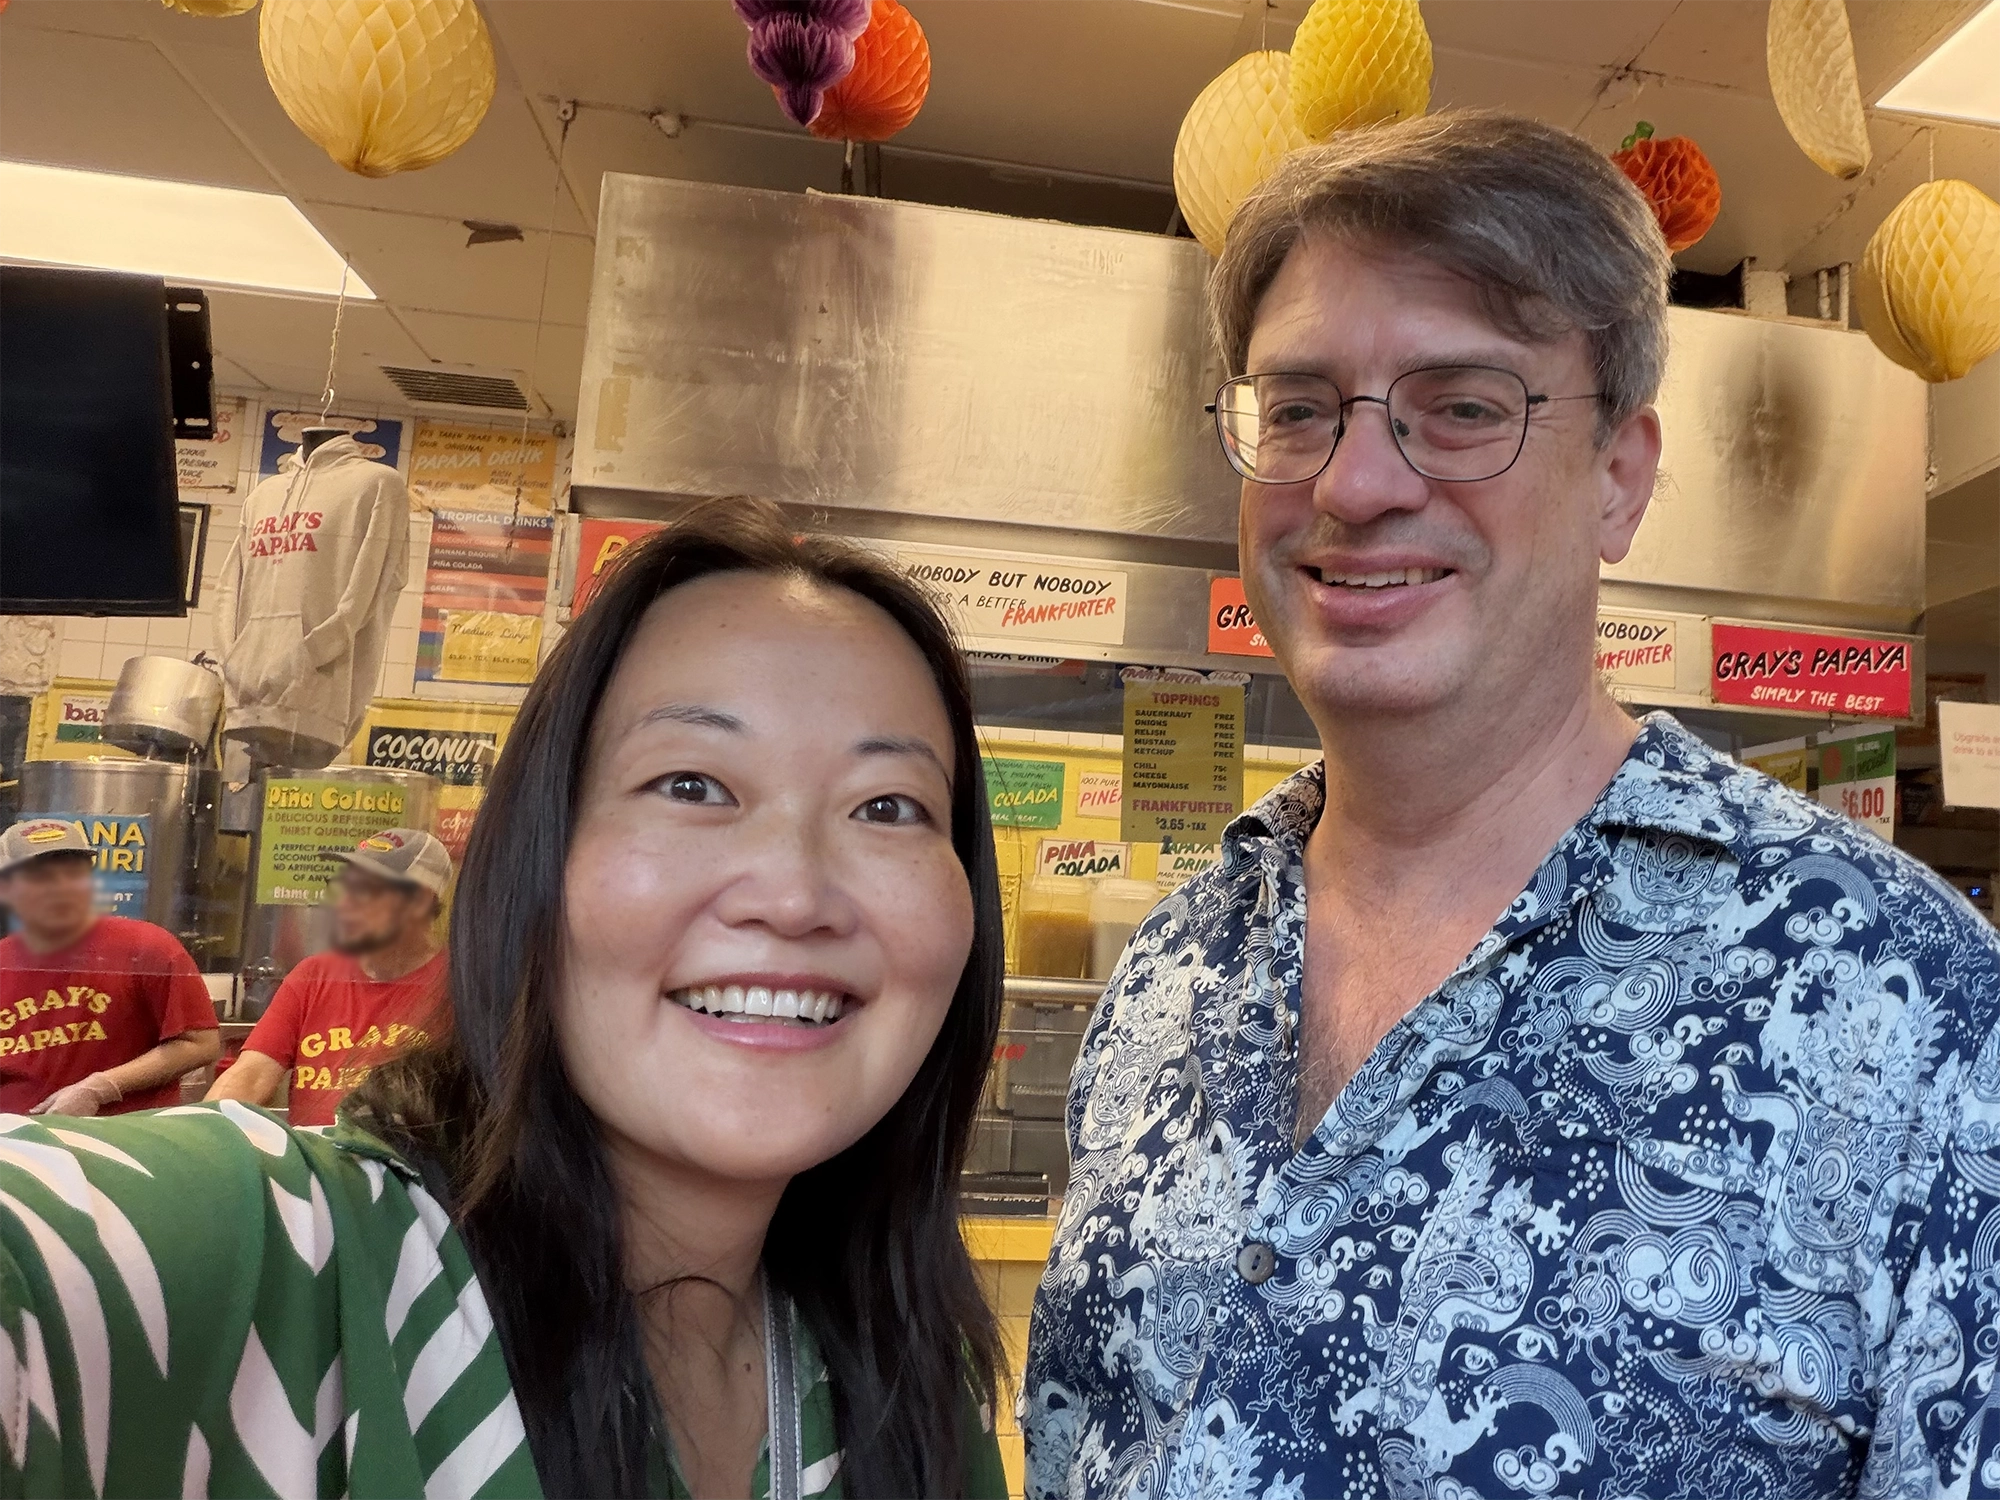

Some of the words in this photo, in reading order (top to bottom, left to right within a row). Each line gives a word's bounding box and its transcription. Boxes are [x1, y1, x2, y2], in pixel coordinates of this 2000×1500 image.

[415, 452, 481, 471] PAPAYA
[487, 449, 544, 467] DRINK
[253, 512, 323, 537] GRAY'S
[440, 510, 500, 525] TROPICAL
[503, 515, 548, 528] DRINKS
[248, 533, 318, 557] PAPAYA
[452, 561, 483, 570] COLADA
[906, 563, 981, 584] NOBODY
[989, 571, 1027, 589] BUT
[1034, 575, 1111, 596] NOBODY
[958, 595, 970, 607] A
[976, 595, 1026, 611] BETTER
[1001, 597, 1116, 628] FRANKFURTER
[1810, 646, 1907, 676] PAPAYA
[1152, 692, 1220, 707] TOPPINGS
[1750, 685, 1805, 703] SIMPLY
[1810, 690, 1836, 707] THE
[1845, 694, 1885, 711] BEST
[1135, 709, 1192, 718] SAUERKRAUT
[1134, 728, 1166, 736] RELISH
[1135, 719, 1167, 727] ONIONS
[1214, 722, 1235, 730] FREE
[372, 733, 494, 763] COCONUT
[1134, 738, 1177, 746] MUSTARD
[1214, 741, 1235, 749] FREE
[1134, 747, 1174, 756] KETCHUP
[372, 759, 484, 774] CHAMPAGNE
[1133, 762, 1157, 770] CHILI
[1100, 778, 1120, 786] PURE
[1133, 781, 1189, 790] MAYONNAISE
[267, 786, 314, 809] Piña
[320, 787, 404, 814] Colada
[994, 787, 1058, 808] COLADA
[1842, 787, 1884, 820] $6.00
[1133, 799, 1233, 814] FRANKFURTER
[275, 813, 328, 824] DELICIOUS
[332, 814, 399, 827] REFRESHING
[1155, 817, 1184, 831] $3.65
[280, 825, 312, 836] THIRST
[281, 844, 315, 852] PERFECT
[317, 845, 355, 853] MARRIA
[1044, 840, 1096, 864] PINA
[273, 853, 317, 862] COCONUT
[273, 863, 285, 871] NO
[288, 863, 335, 872] ARTIFICIAL
[1053, 854, 1121, 877] COLADA
[293, 873, 305, 881] OF
[273, 885, 309, 900] Blame
[0, 986, 112, 1031] GRAY'S
[0, 1020, 108, 1057] PAPAYA
